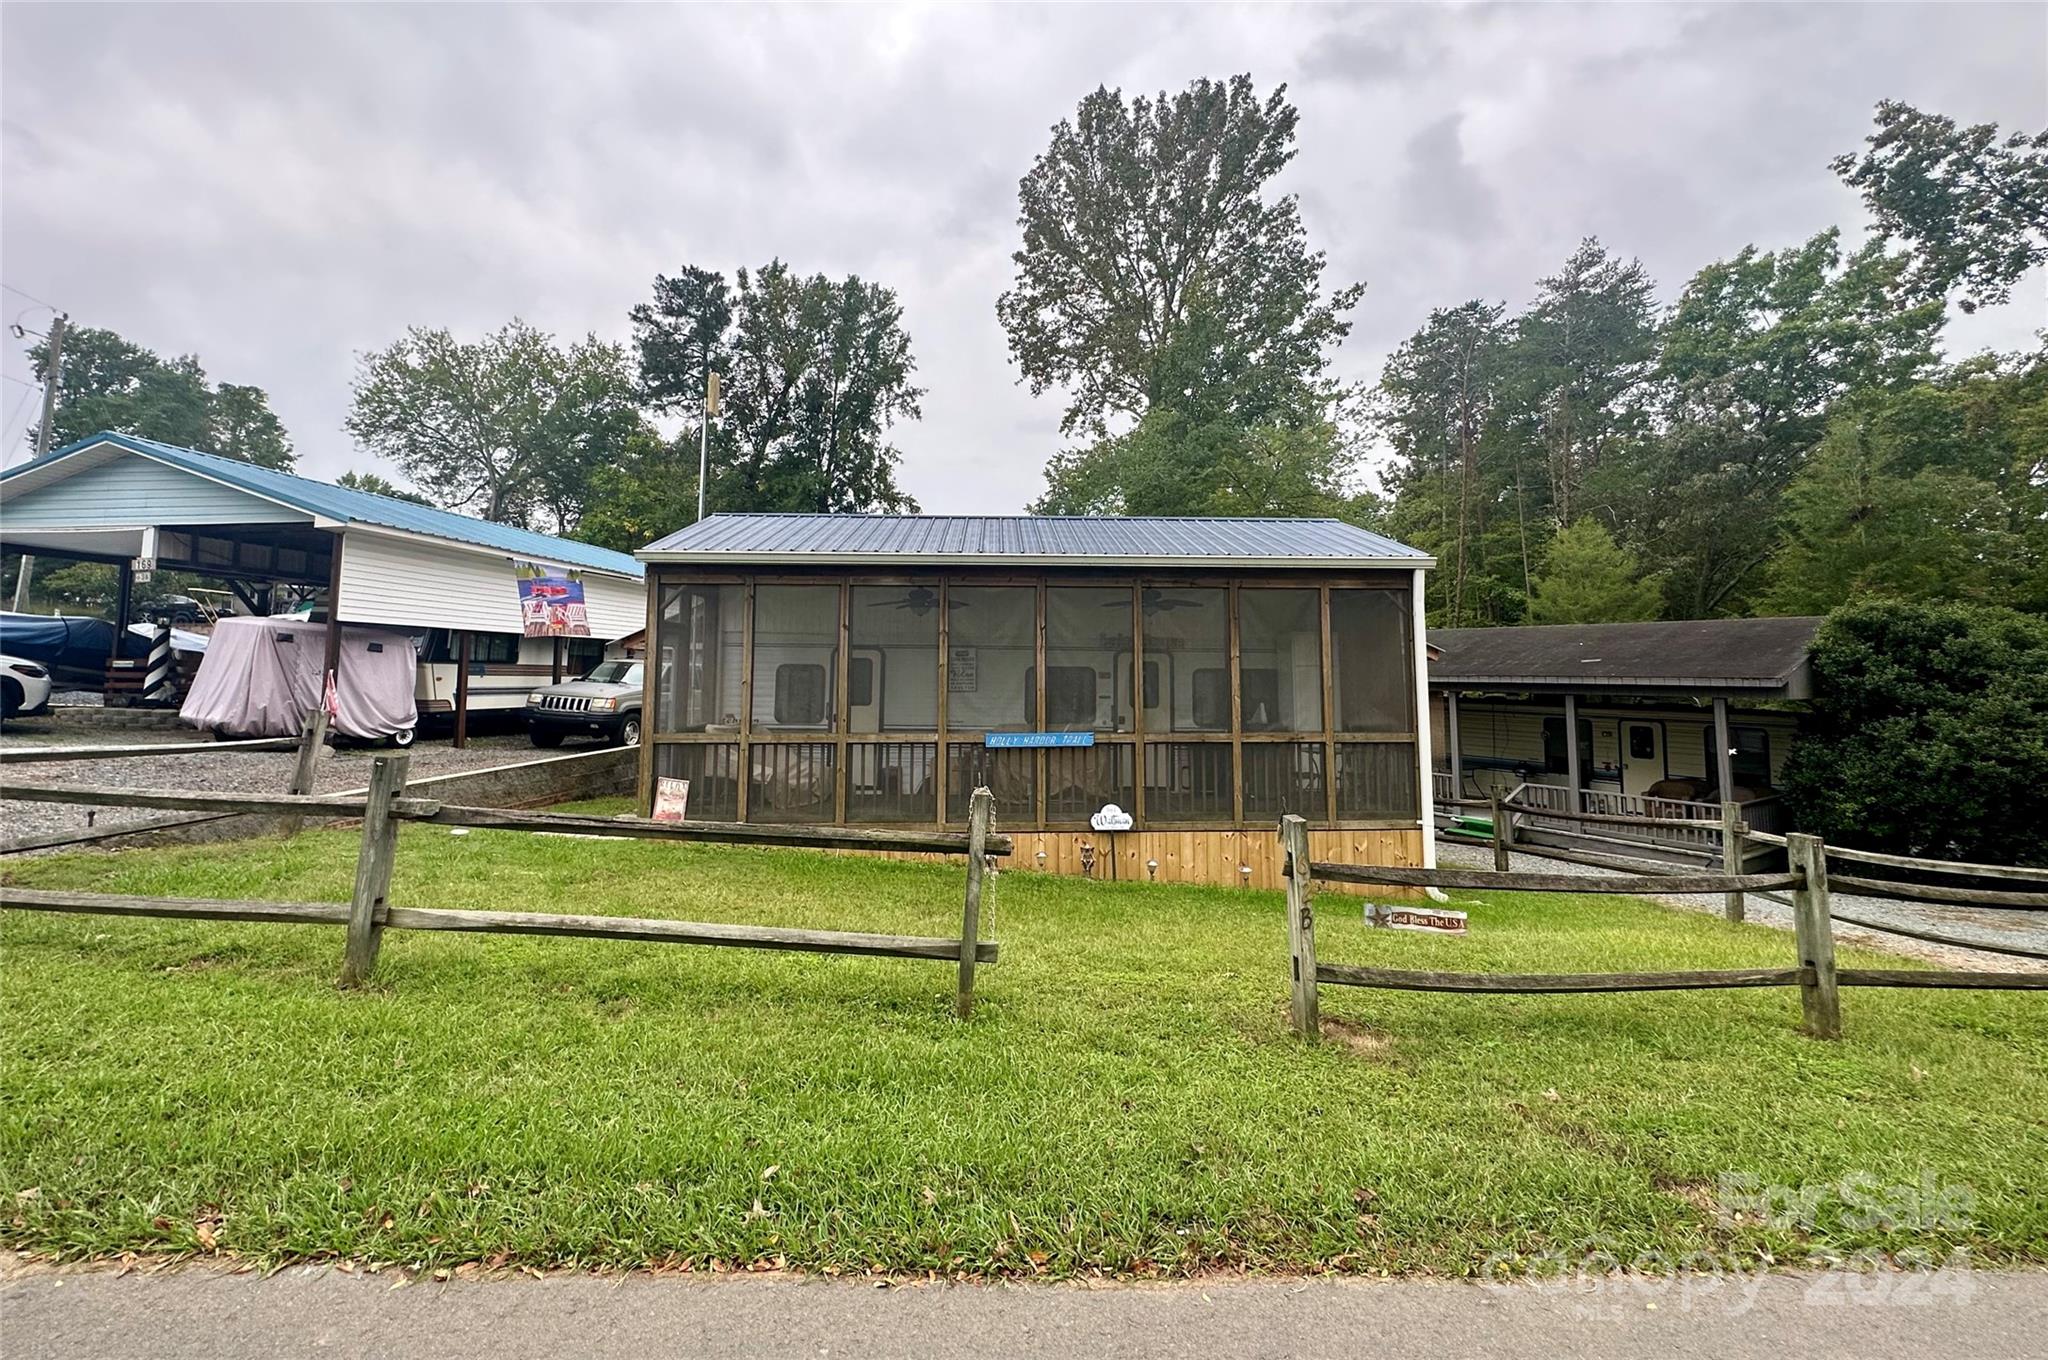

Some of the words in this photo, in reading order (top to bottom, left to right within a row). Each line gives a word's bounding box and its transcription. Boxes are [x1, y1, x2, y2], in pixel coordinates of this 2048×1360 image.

[137, 560, 152, 569] 169
[990, 736, 1018, 745] HOLLY
[1023, 736, 1056, 745] HARBOR
[1392, 913, 1407, 923] God
[1409, 914, 1428, 926] Bless
[1429, 916, 1444, 927] The
